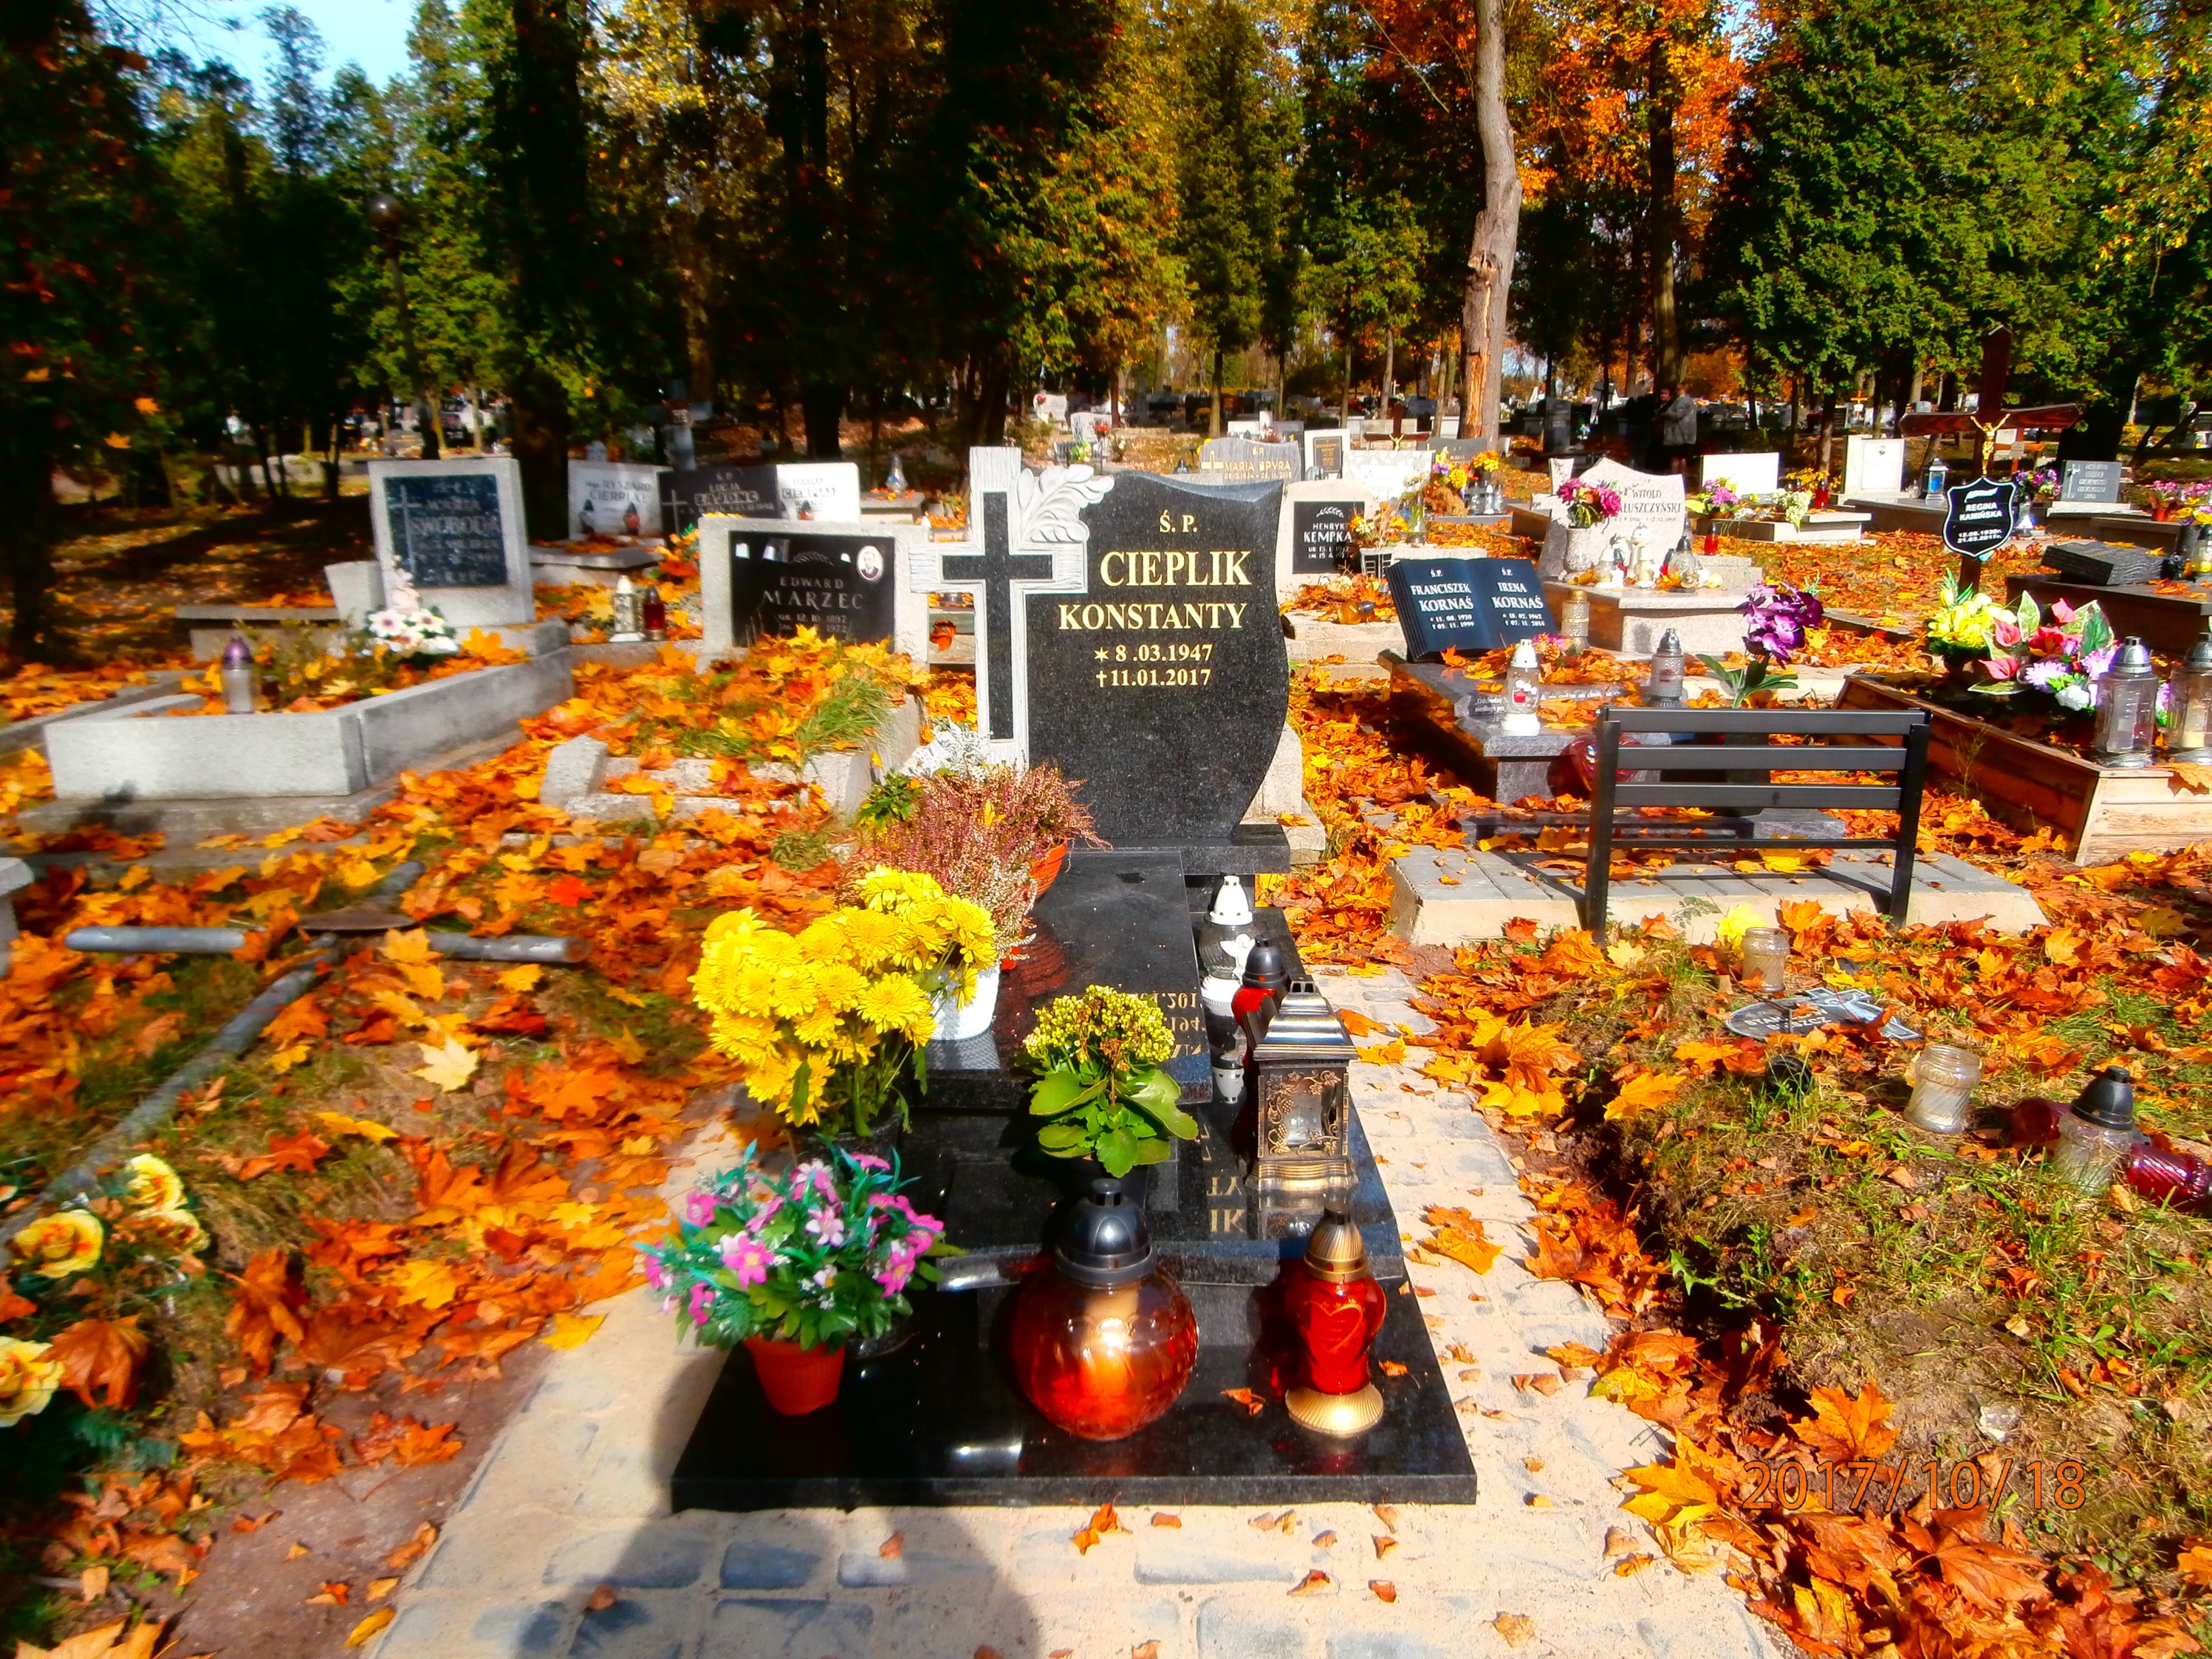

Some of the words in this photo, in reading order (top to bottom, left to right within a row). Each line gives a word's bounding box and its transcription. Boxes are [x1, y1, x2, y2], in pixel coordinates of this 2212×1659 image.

[1225, 461, 1255, 471] MARIA
[1259, 461, 1291, 471] SPYRA
[1632, 489, 1662, 499] WITOLD
[1965, 502, 1997, 512] REGINA
[1160, 510, 1176, 533] Ś.
[1182, 514, 1198, 533] P.
[1959, 510, 2002, 521] KAMIŃSKA
[1312, 522, 1344, 530] HENRYK
[1304, 531, 1352, 544] KĘMPKA
[1100, 550, 1252, 586] CIEPLIK
[780, 576, 844, 589] EDWARD
[1410, 583, 1472, 595] FRANCISZEK
[1498, 582, 1527, 592] IRENA
[762, 590, 863, 611] MARZEC
[1419, 595, 1473, 612] KORNAŚ
[1491, 595, 1543, 609] KORNAŚ
[1058, 603, 1247, 629] KONSTANTY
